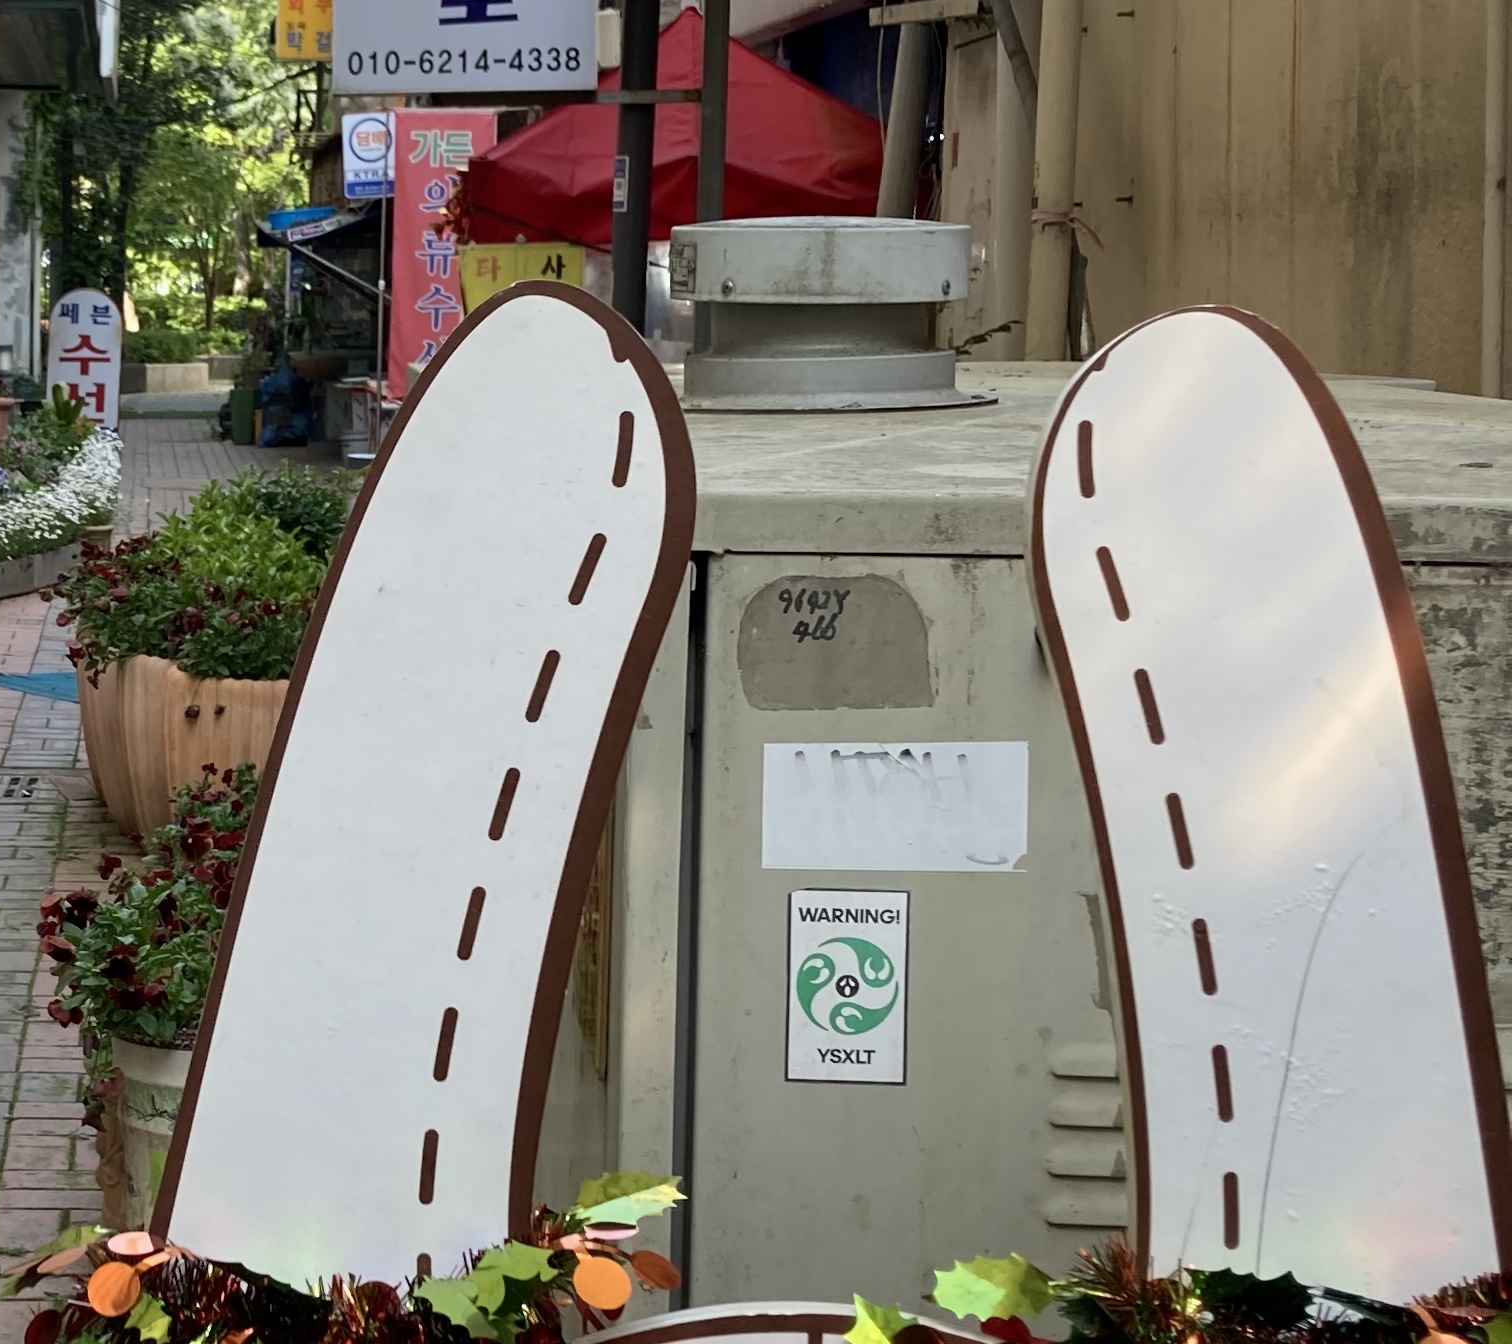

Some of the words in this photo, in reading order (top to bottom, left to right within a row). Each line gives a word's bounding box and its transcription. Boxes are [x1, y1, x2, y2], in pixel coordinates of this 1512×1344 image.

[347, 47, 582, 76] 010-6214-4338
[408, 130, 474, 168] 가든
[798, 906, 901, 925] WARNING!
[816, 1047, 876, 1065] YSXLT
